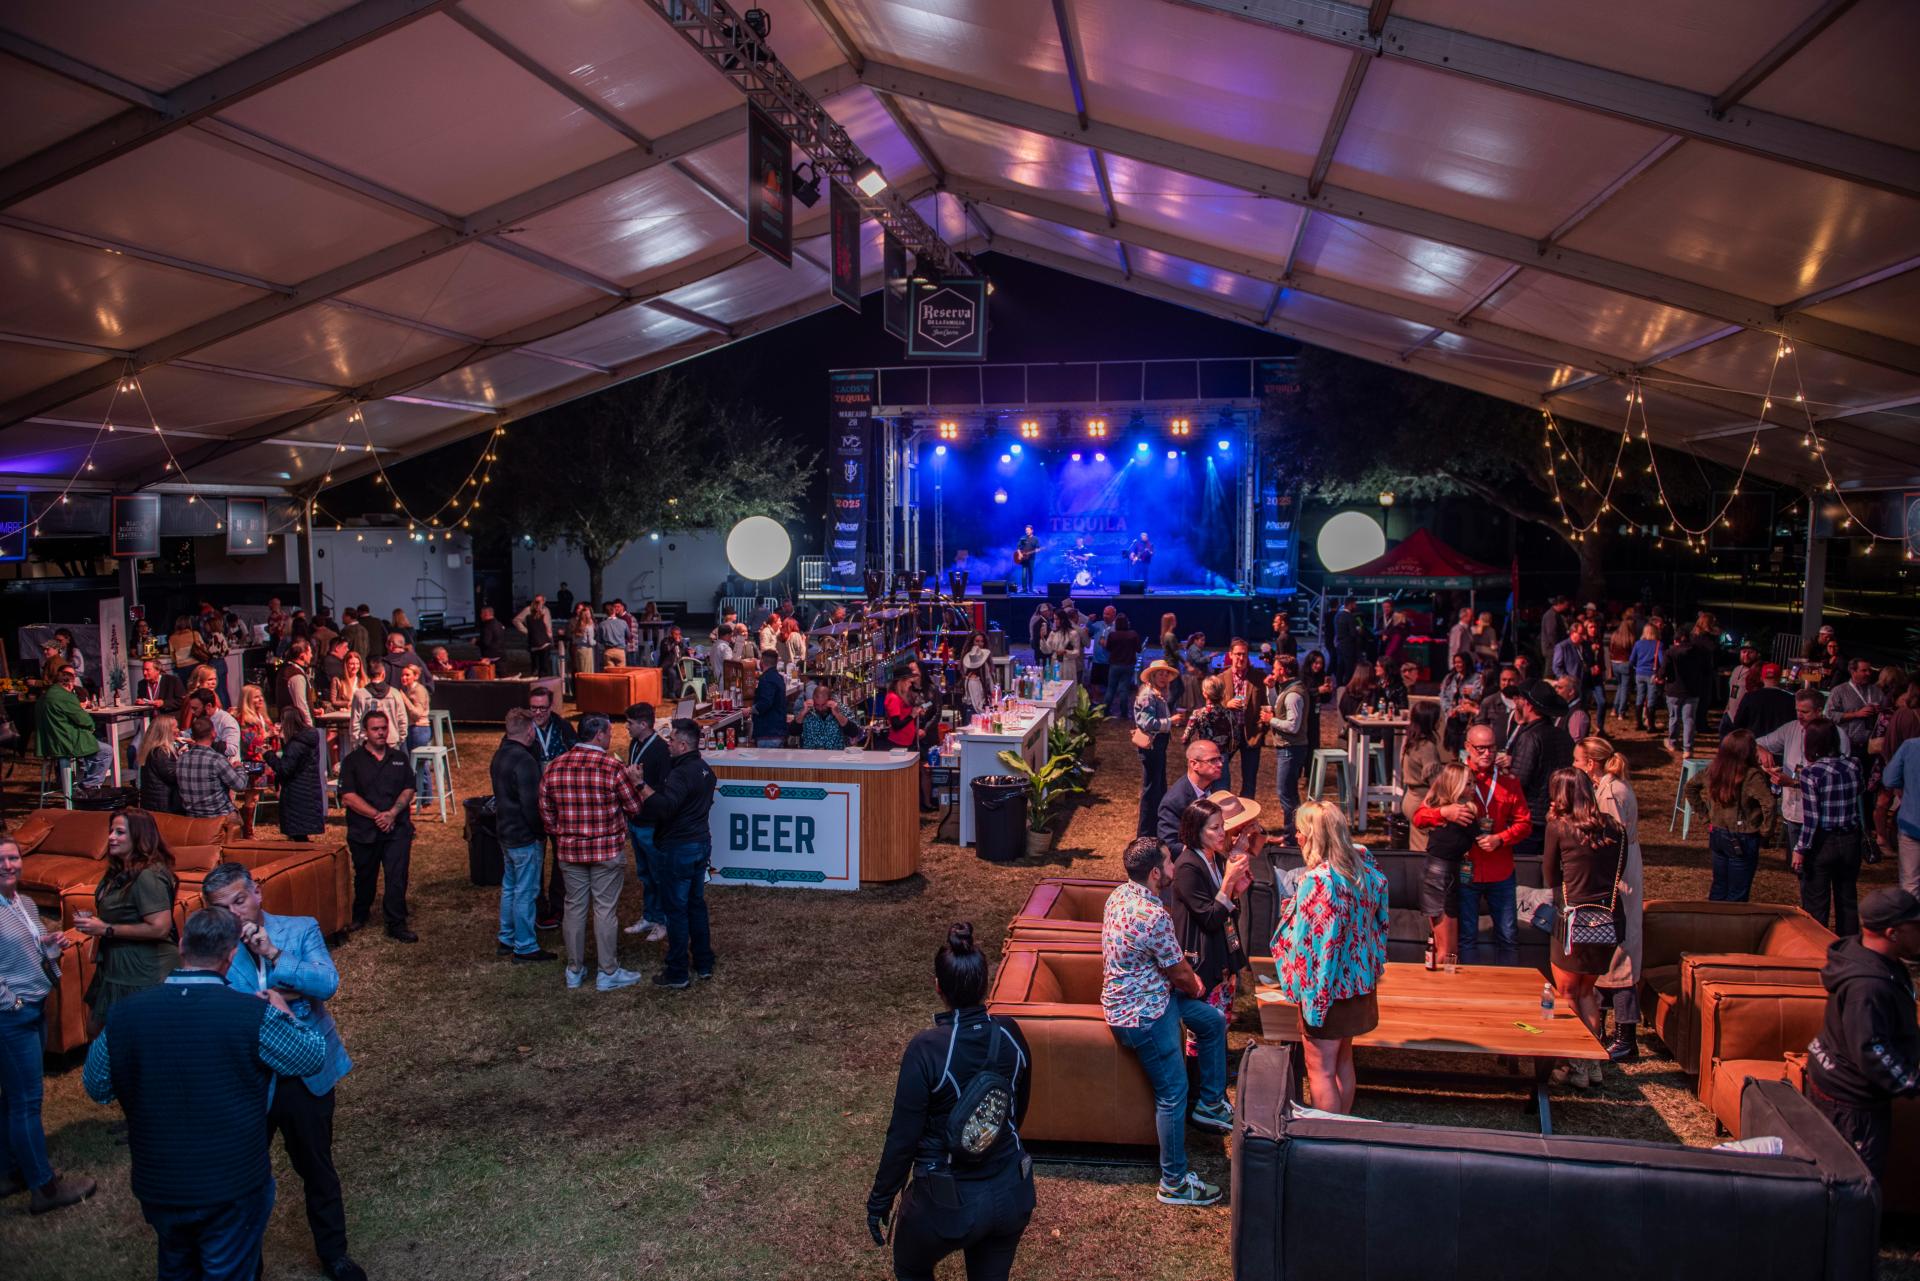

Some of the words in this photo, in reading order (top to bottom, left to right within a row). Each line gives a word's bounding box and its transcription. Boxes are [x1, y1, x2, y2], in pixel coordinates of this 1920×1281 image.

[923, 305, 971, 319] Reserva
[834, 394, 871, 403] TEQUILA
[835, 499, 860, 508] 2025
[1050, 517, 1127, 532] TEQUILA
[729, 813, 815, 854] BEER
